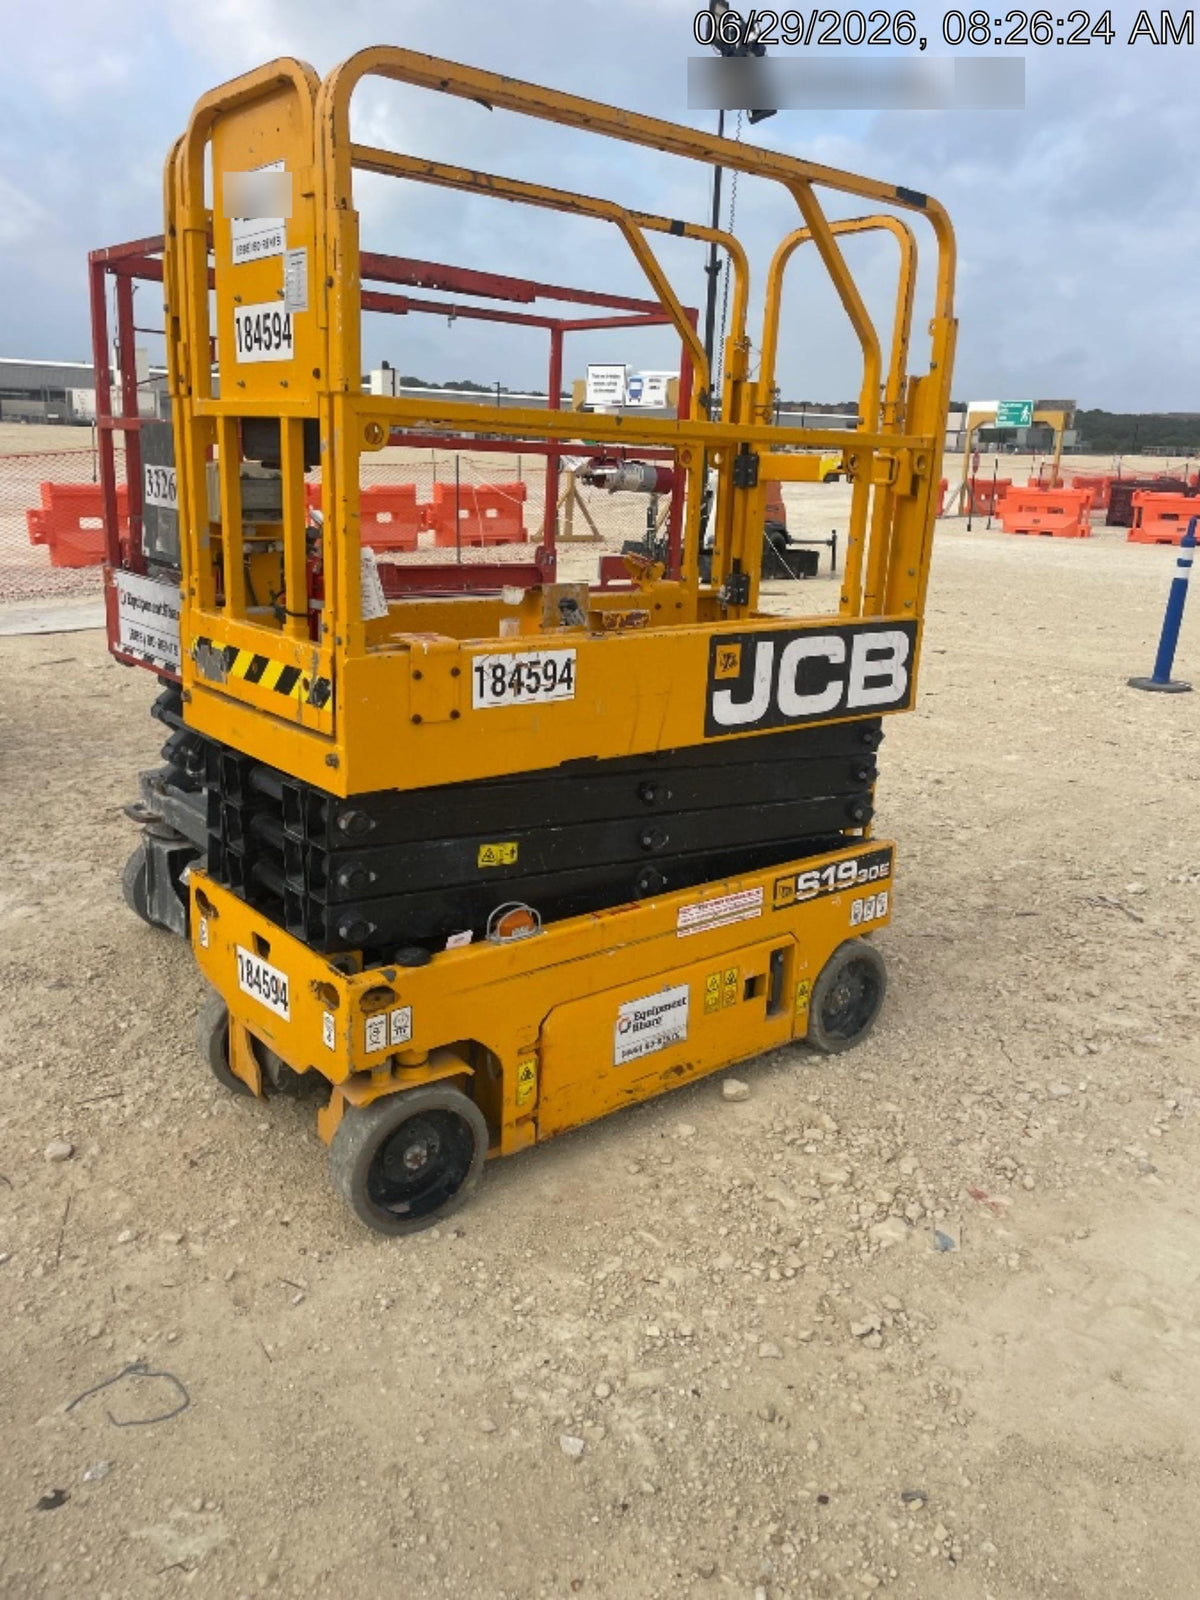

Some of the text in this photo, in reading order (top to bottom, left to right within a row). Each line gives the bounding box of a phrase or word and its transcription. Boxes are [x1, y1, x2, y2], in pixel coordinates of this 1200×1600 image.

[235, 311, 293, 353] 184594
[473, 658, 574, 699] 184594
[711, 630, 910, 726] JCB
[237, 953, 289, 1012] 184594
